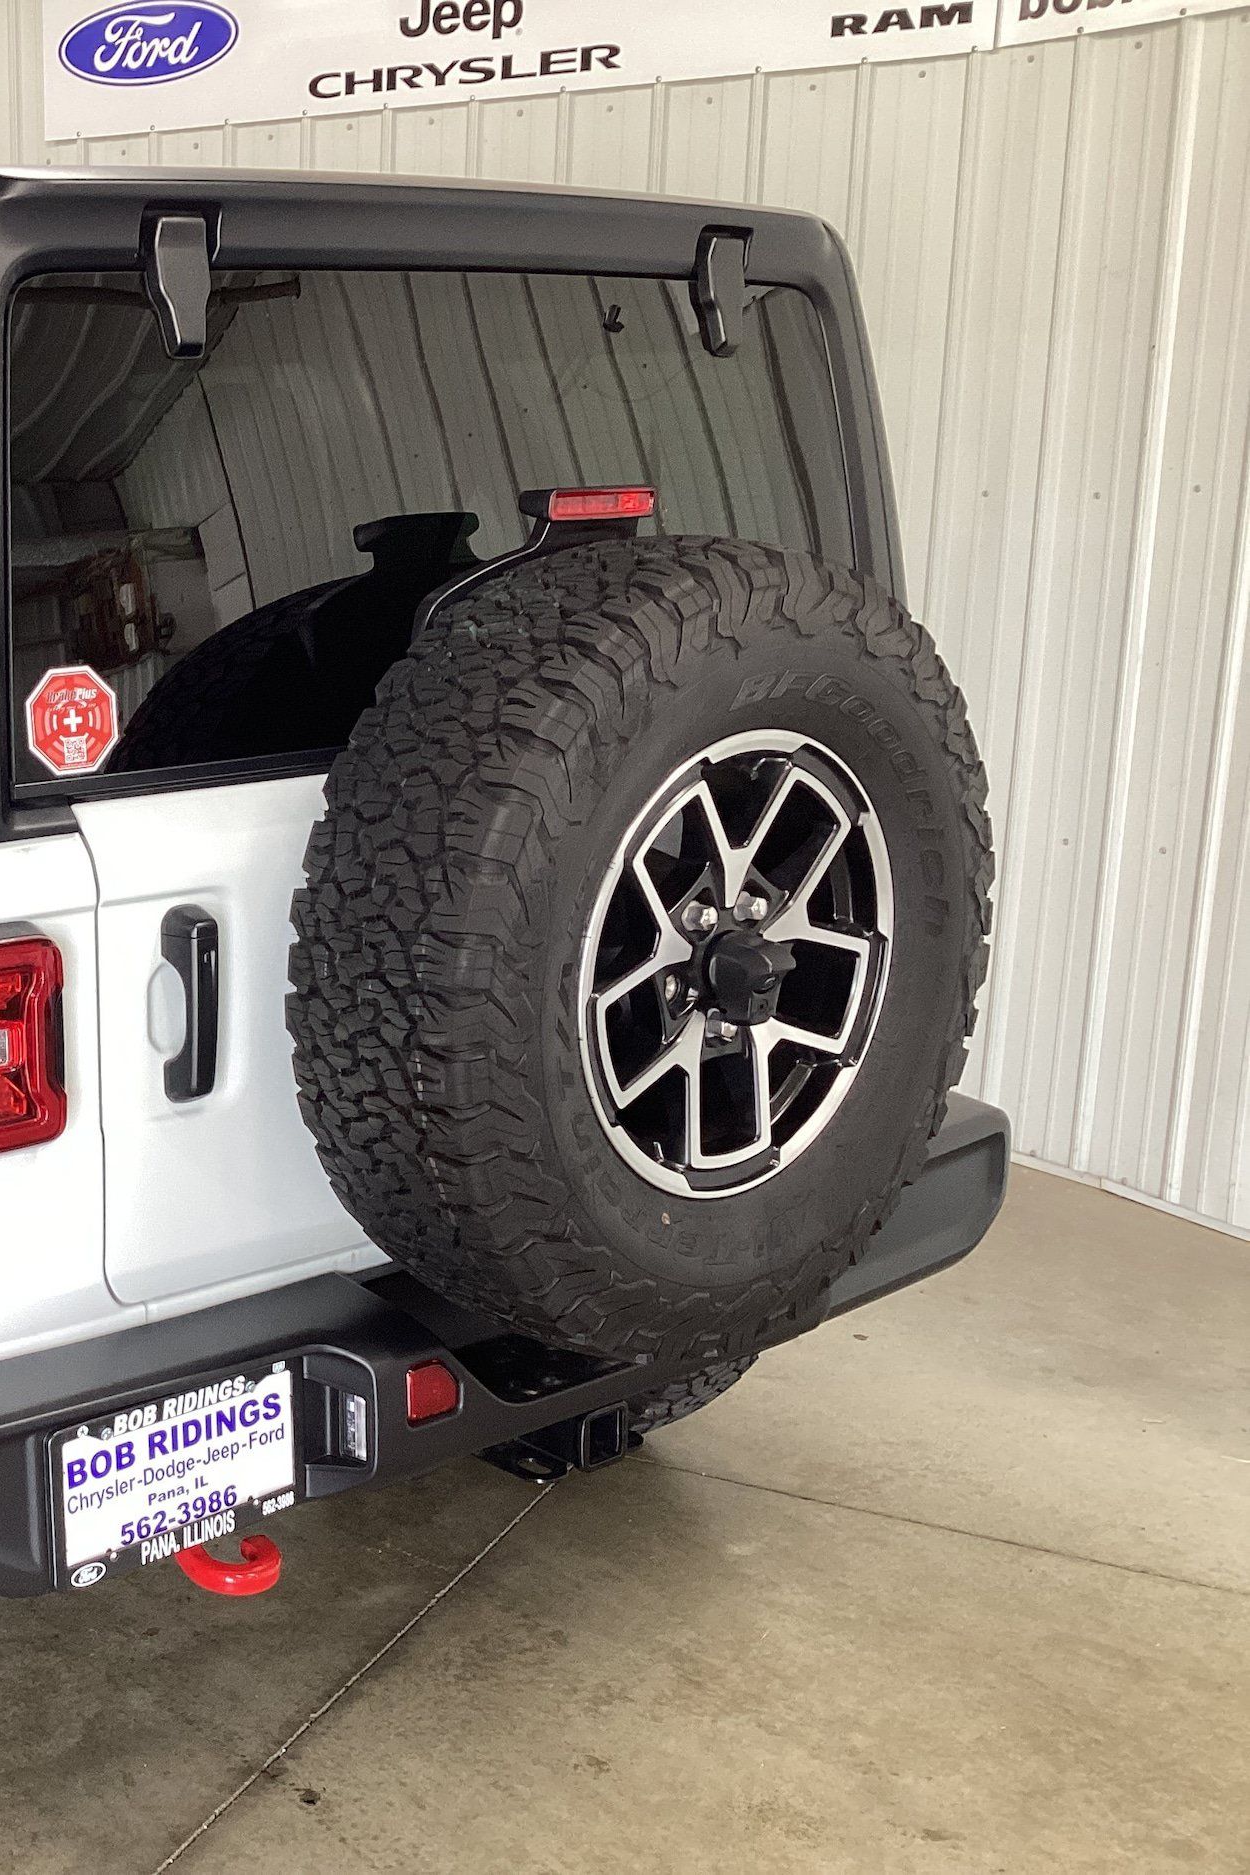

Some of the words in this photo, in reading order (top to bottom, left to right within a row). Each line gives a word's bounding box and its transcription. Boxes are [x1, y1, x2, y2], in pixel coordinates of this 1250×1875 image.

[93, 12, 199, 71] Ford
[399, 0, 523, 39] Jeep
[830, 2, 973, 38] RAM
[308, 44, 622, 99] CHRYSLER
[113, 1404, 158, 1437] BOB
[162, 1375, 247, 1419] RIDINGS
[67, 1440, 136, 1490] BOB
[147, 1392, 282, 1461] RIDINGS
[67, 1423, 285, 1515] Chrysler-Dodge-Jeep-Ford
[120, 1484, 238, 1546] 562-3986
[147, 1486, 190, 1506] Pana,
[194, 1476, 209, 1489] IL
[183, 1509, 236, 1549] ILLINOIS
